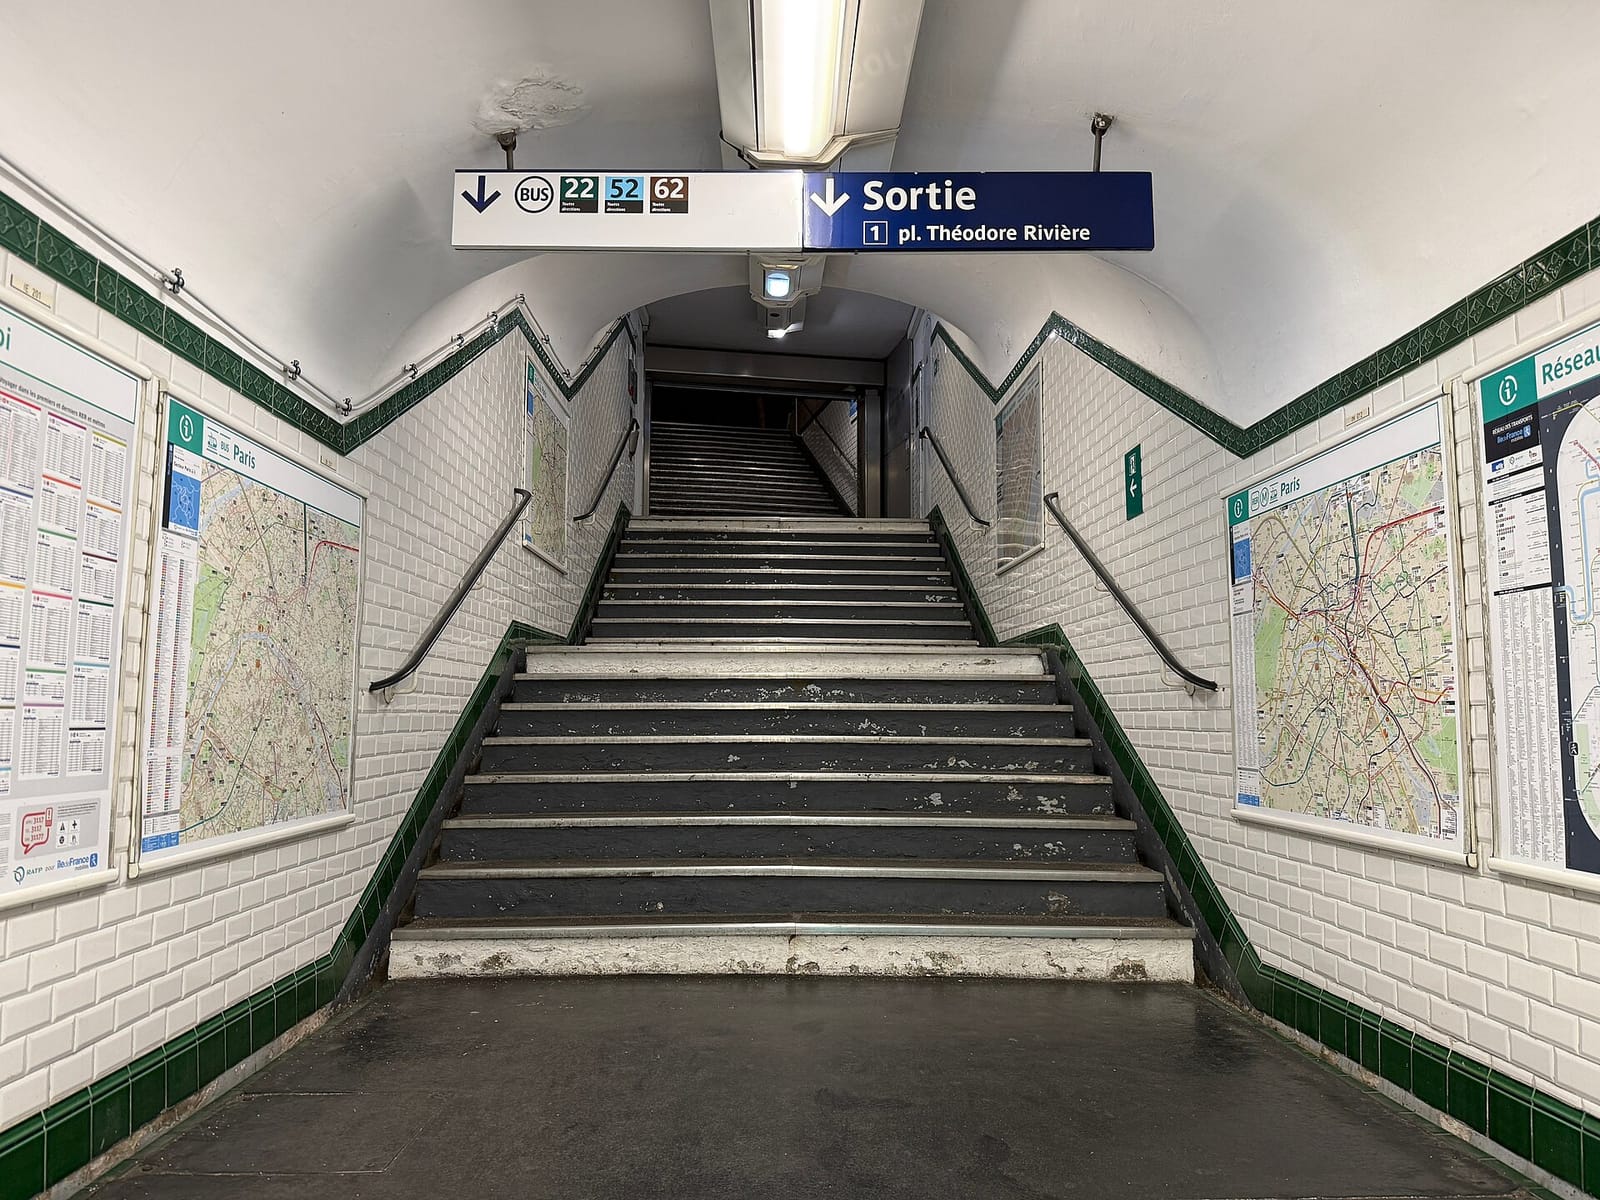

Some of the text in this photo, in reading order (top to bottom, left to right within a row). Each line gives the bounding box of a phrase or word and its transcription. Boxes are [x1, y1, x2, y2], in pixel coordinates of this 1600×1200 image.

[520, 178, 685, 202] BUS 22 52 62
[862, 180, 976, 212] Sortie
[869, 224, 1090, 245] 1 pl. Théodore Rivière
[233, 444, 256, 470] Paris
[1280, 476, 1300, 496] Paris
